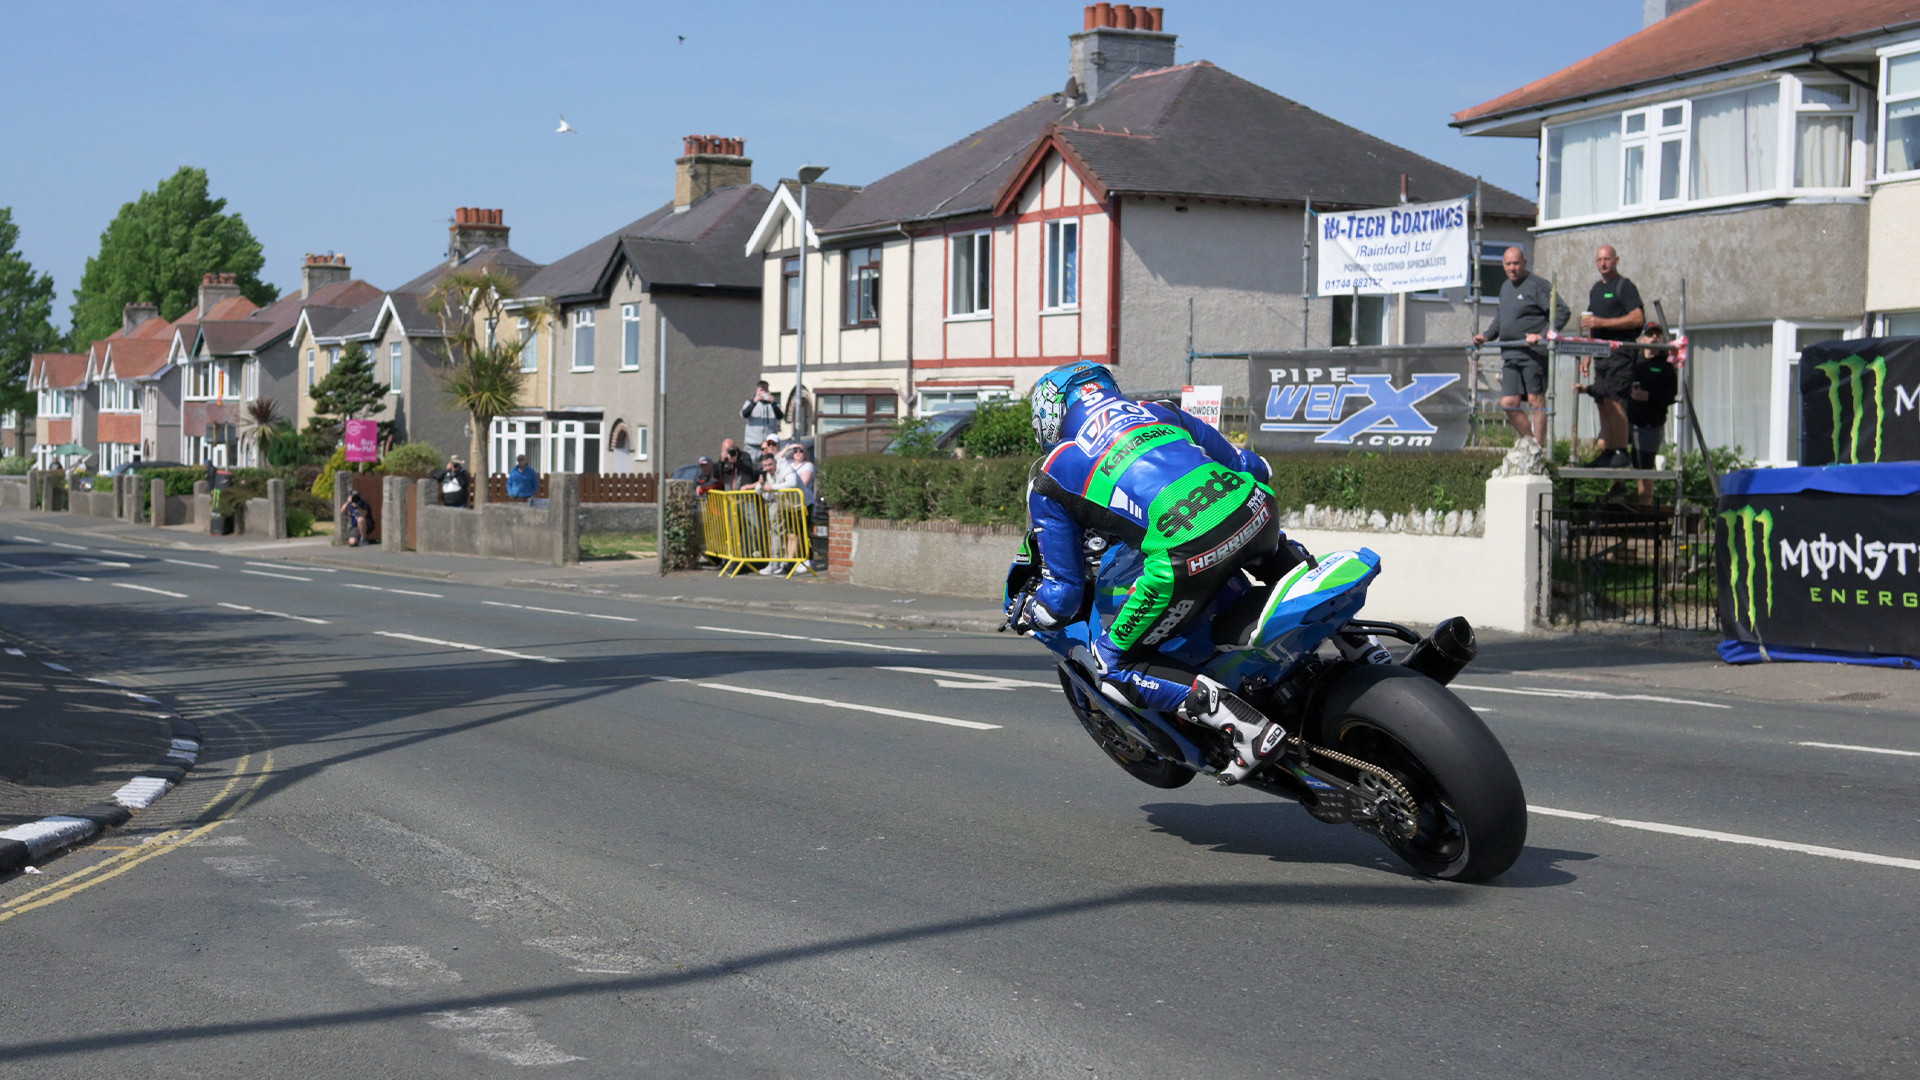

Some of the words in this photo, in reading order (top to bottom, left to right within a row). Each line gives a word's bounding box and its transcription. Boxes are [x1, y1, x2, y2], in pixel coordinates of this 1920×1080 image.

[1391, 204, 1463, 235] COATINGS
[1414, 239, 1432, 252] Ltd
[1372, 260, 1404, 272] COATING
[1407, 256, 1447, 269] SPECIALISTS
[1269, 367, 1348, 382] PIPE
[1188, 405, 1219, 416] HOWDENS
[1100, 427, 1176, 476] Kawasaki
[1357, 435, 1433, 446] .com
[1157, 470, 1246, 538] spada
[1190, 508, 1269, 572] HARRISON
[1142, 600, 1195, 645] spada
